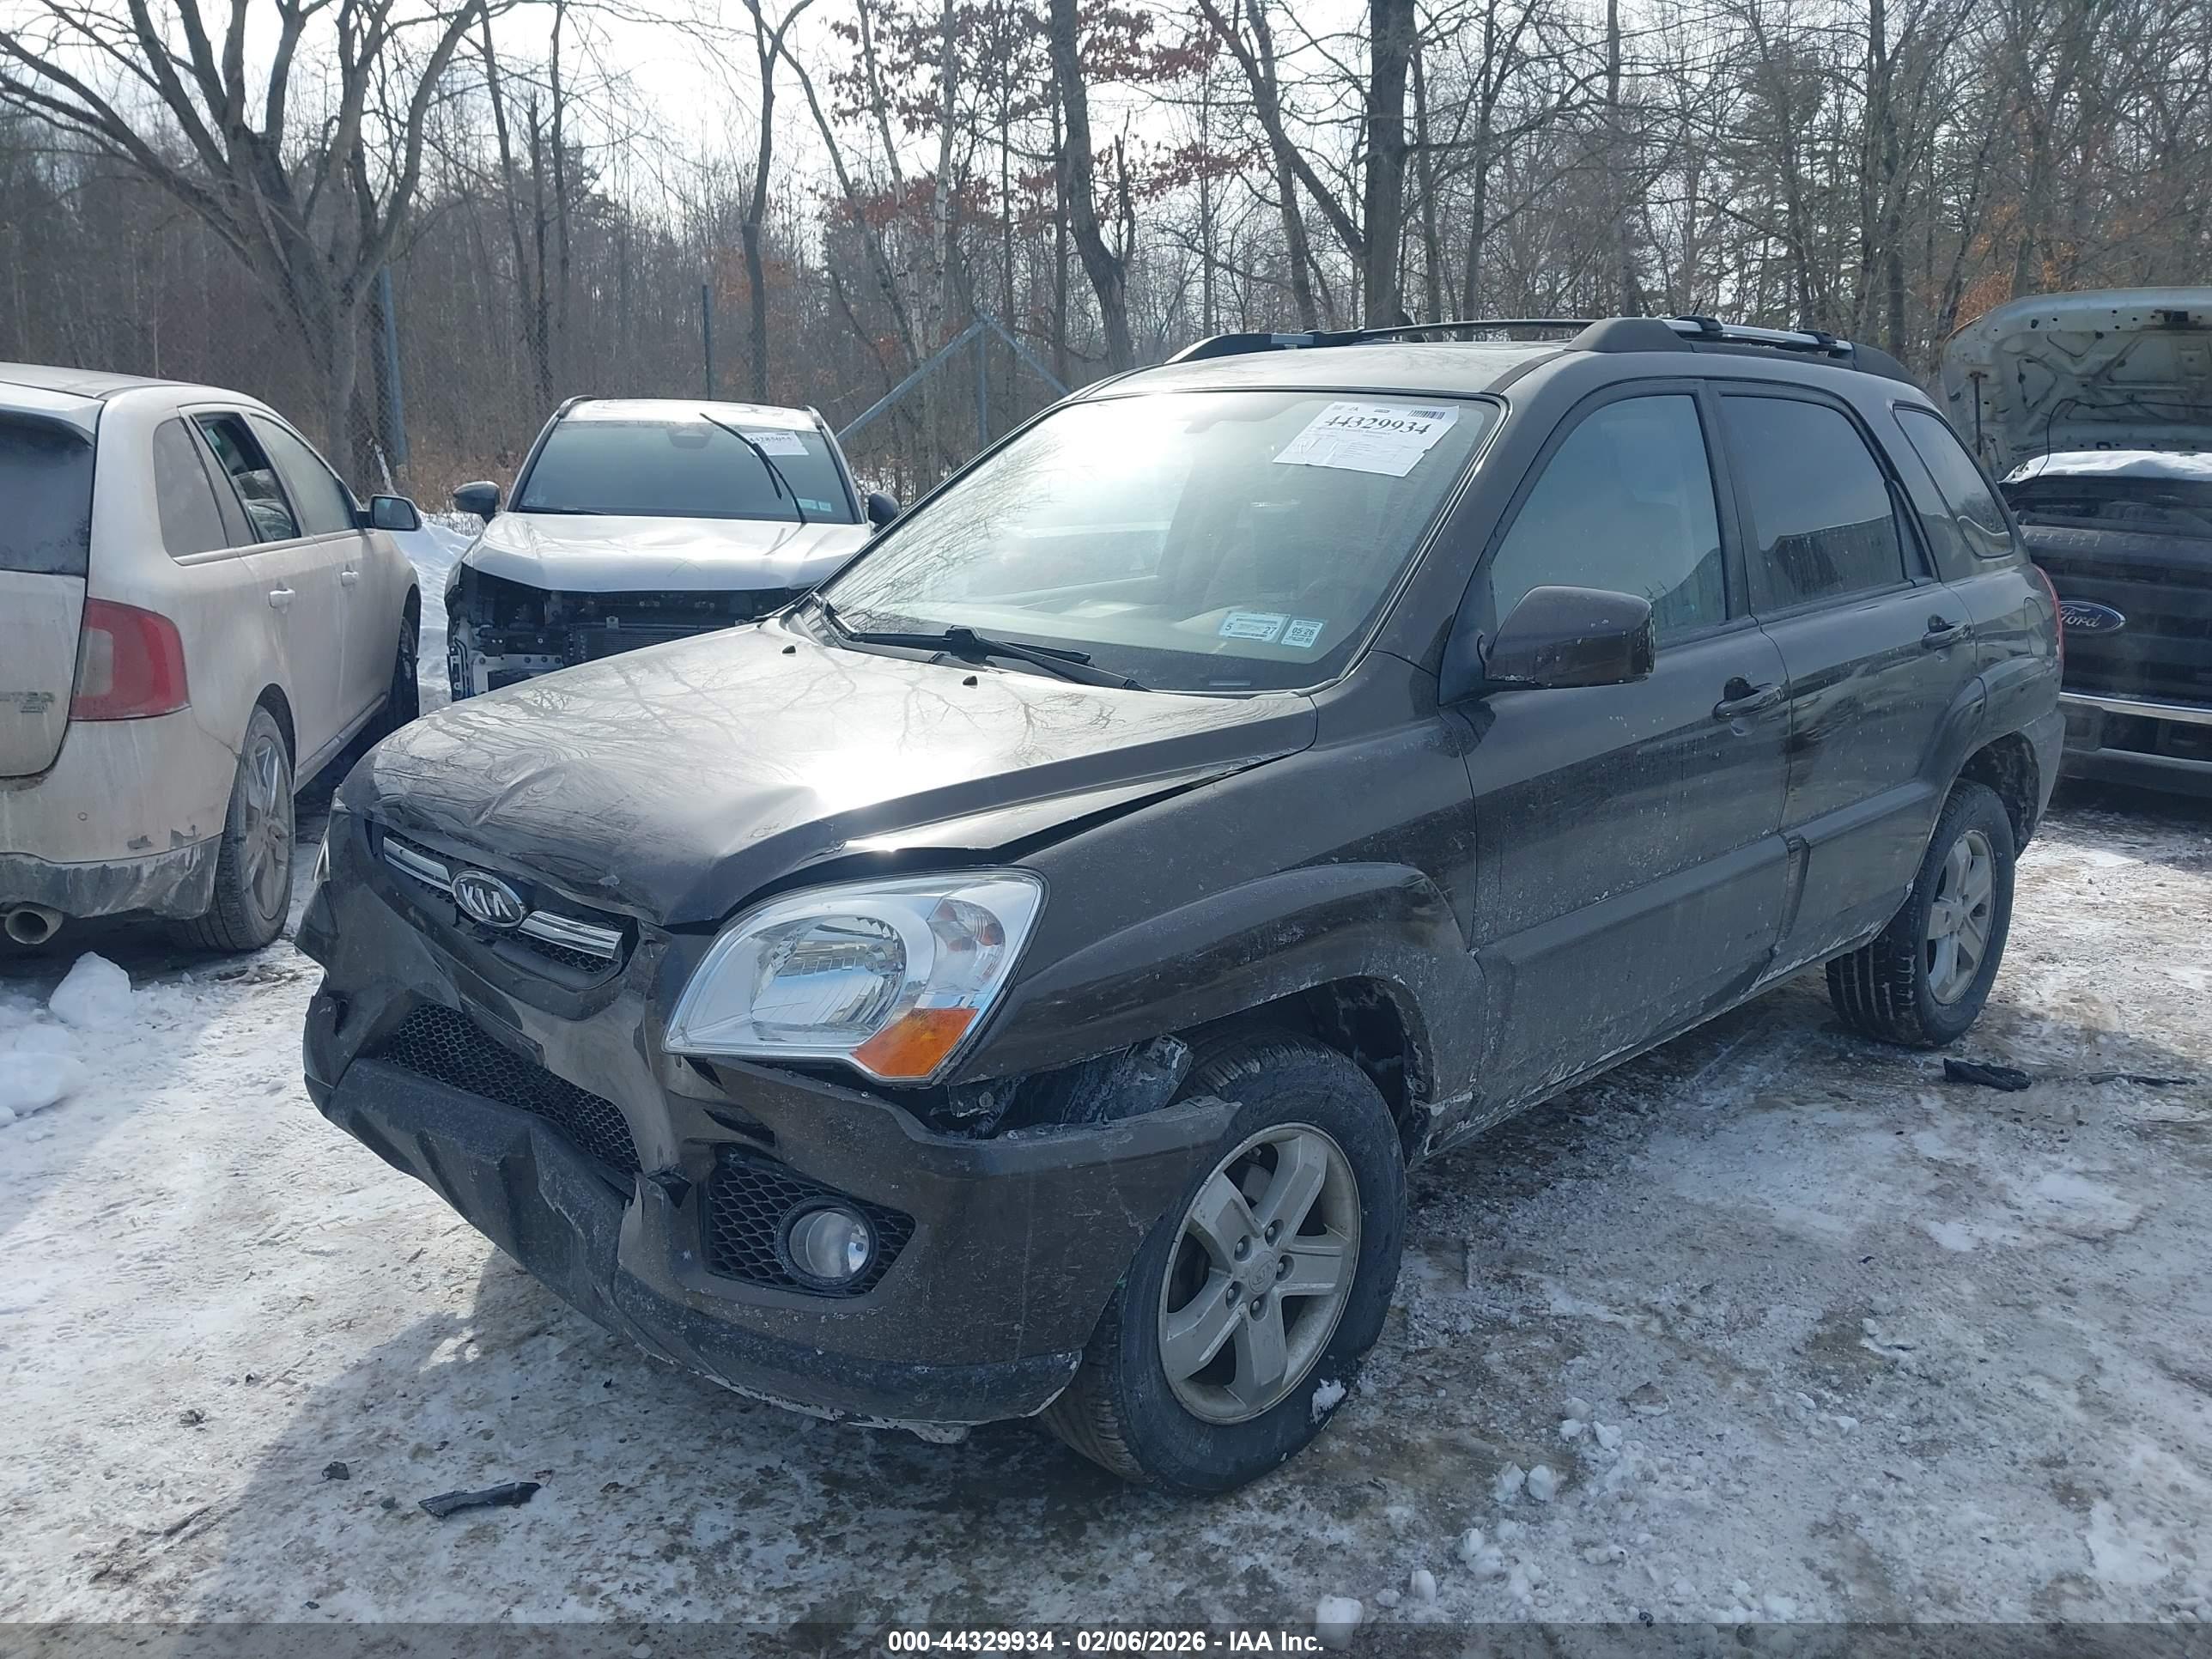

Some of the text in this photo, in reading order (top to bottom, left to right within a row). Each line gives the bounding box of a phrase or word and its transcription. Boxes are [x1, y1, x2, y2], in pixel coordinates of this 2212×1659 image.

[1325, 415, 1432, 435] 44329934
[2060, 605, 2102, 627] Ford
[1262, 626, 1278, 635] 27
[460, 883, 514, 918] KIA
